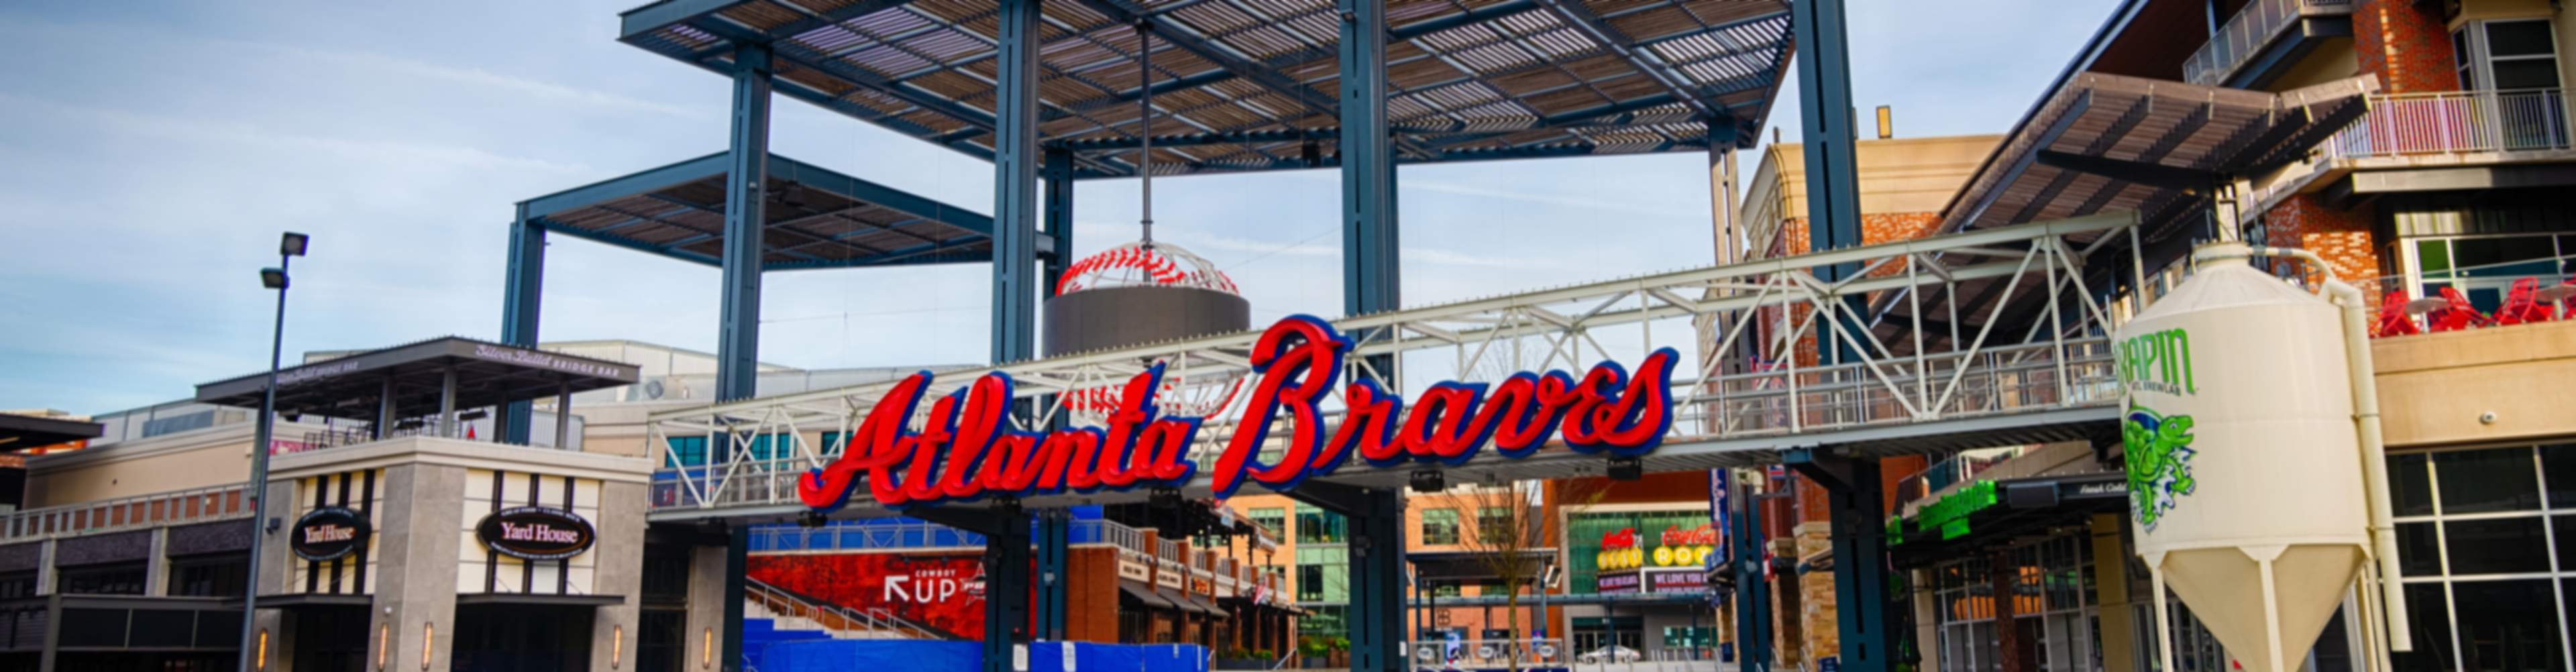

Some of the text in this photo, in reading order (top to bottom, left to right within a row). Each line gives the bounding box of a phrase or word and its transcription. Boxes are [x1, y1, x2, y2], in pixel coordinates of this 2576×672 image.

[553, 357, 593, 374] BRIDGE
[596, 366, 619, 377] BAR
[798, 314, 1679, 514] Atlanta Braves
[501, 521, 579, 543] Yard House
[915, 569, 956, 577] COWBOY
[915, 578, 956, 603] UP
